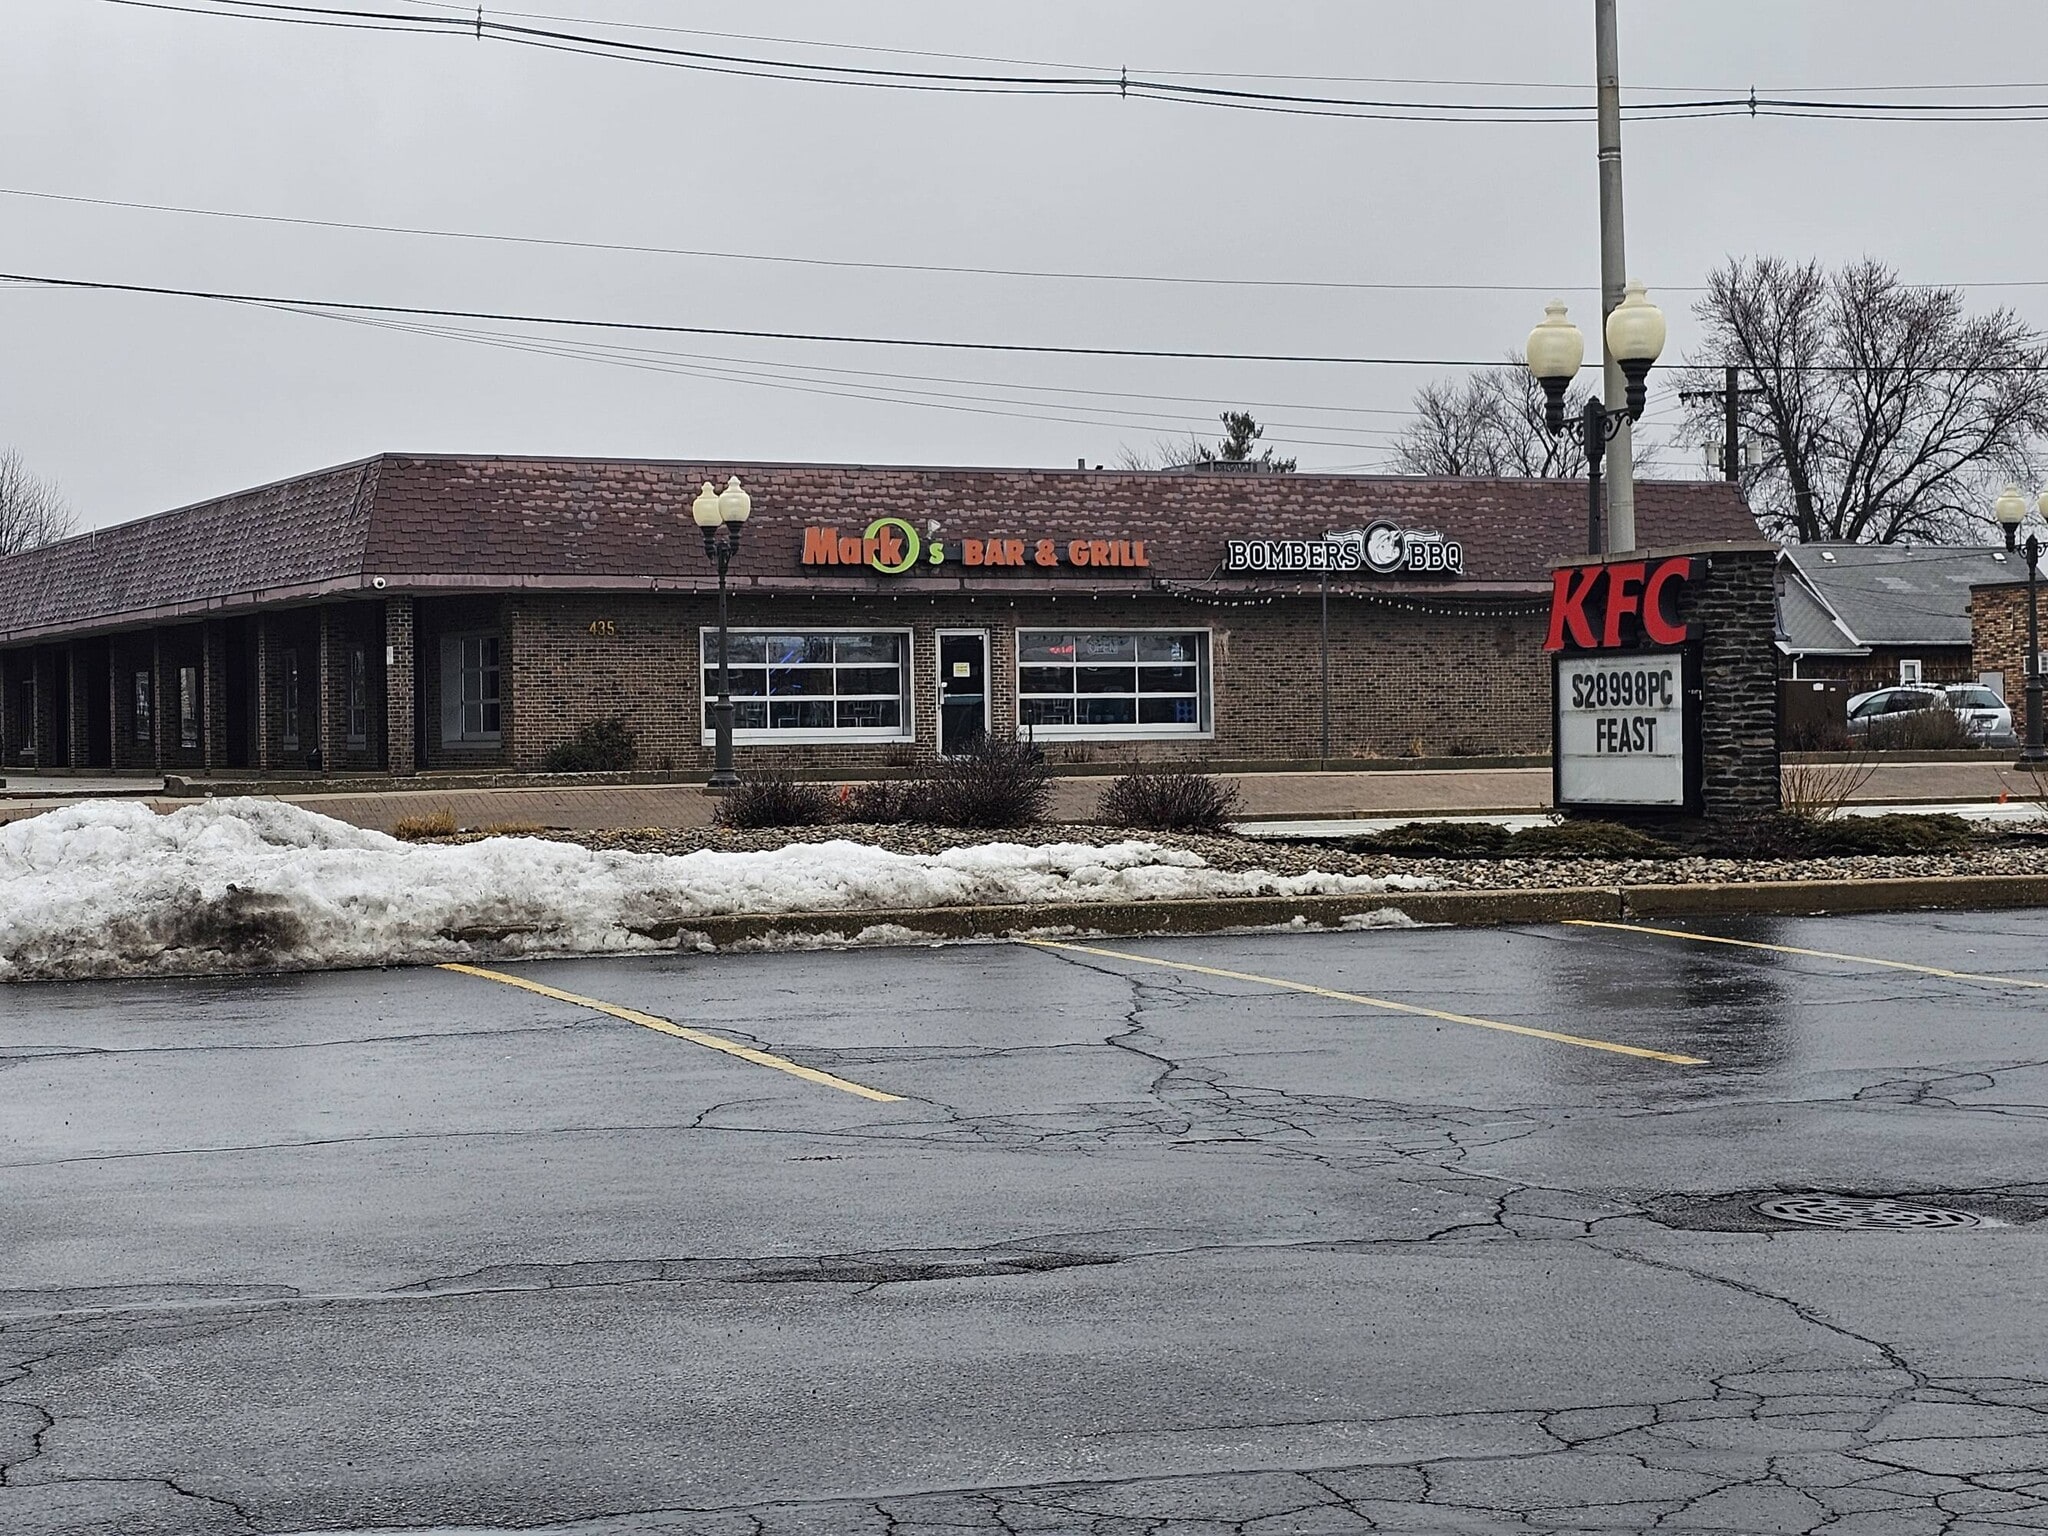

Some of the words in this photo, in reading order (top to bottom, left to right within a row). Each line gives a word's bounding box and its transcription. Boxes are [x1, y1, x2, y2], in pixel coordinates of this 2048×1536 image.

[962, 539, 1025, 567] BAR
[1034, 539, 1059, 567] &
[1068, 540, 1149, 567] GRILL
[1228, 541, 1361, 571] BOMBERS
[1408, 541, 1464, 574] BBQ
[1544, 557, 1691, 651] KFC
[589, 620, 616, 636] 435
[1596, 716, 1657, 753] FEAST
